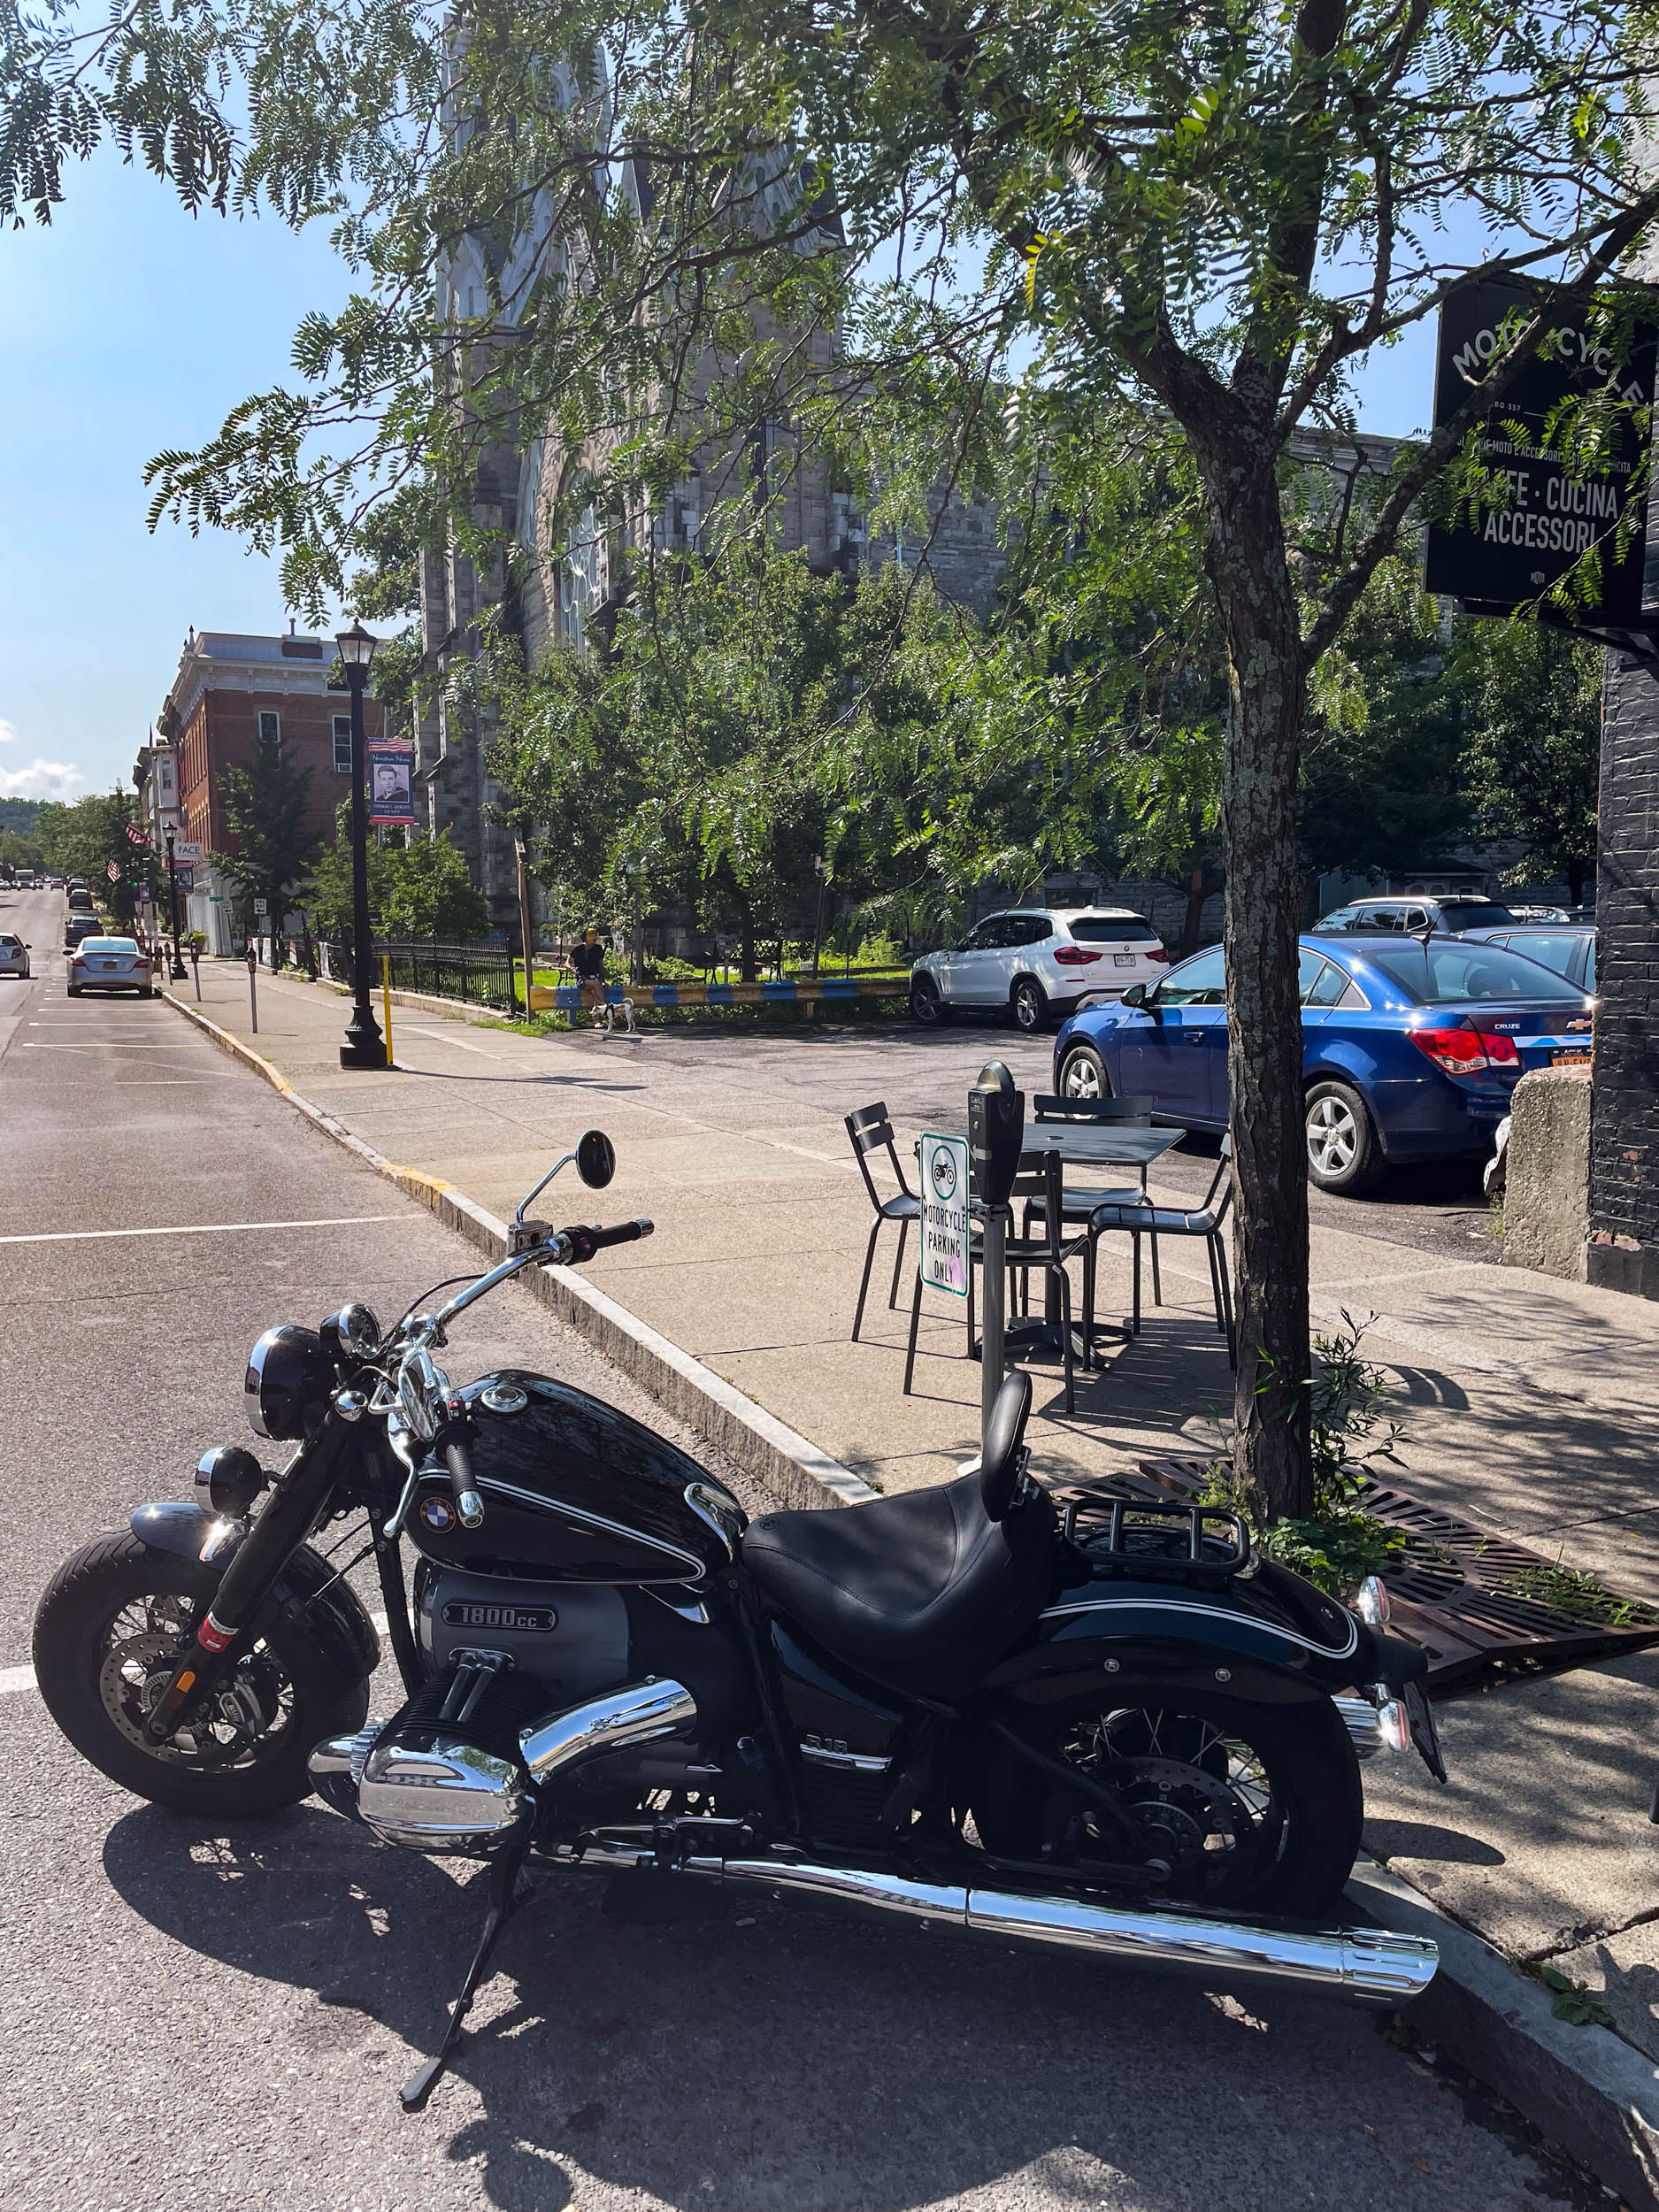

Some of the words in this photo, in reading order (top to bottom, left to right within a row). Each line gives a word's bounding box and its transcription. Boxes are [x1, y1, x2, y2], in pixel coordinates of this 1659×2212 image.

[1521, 447, 1562, 463] ACCESORI
[1547, 477, 1618, 519] CUCINA
[1484, 510, 1597, 554] ACCESSORI
[178, 846, 200, 855] FACE
[923, 1203, 966, 1233] MOTORCYCLE
[928, 1231, 961, 1258] PARKING
[934, 1259, 954, 1284] ONLY
[460, 1607, 538, 1627] 1800cc
